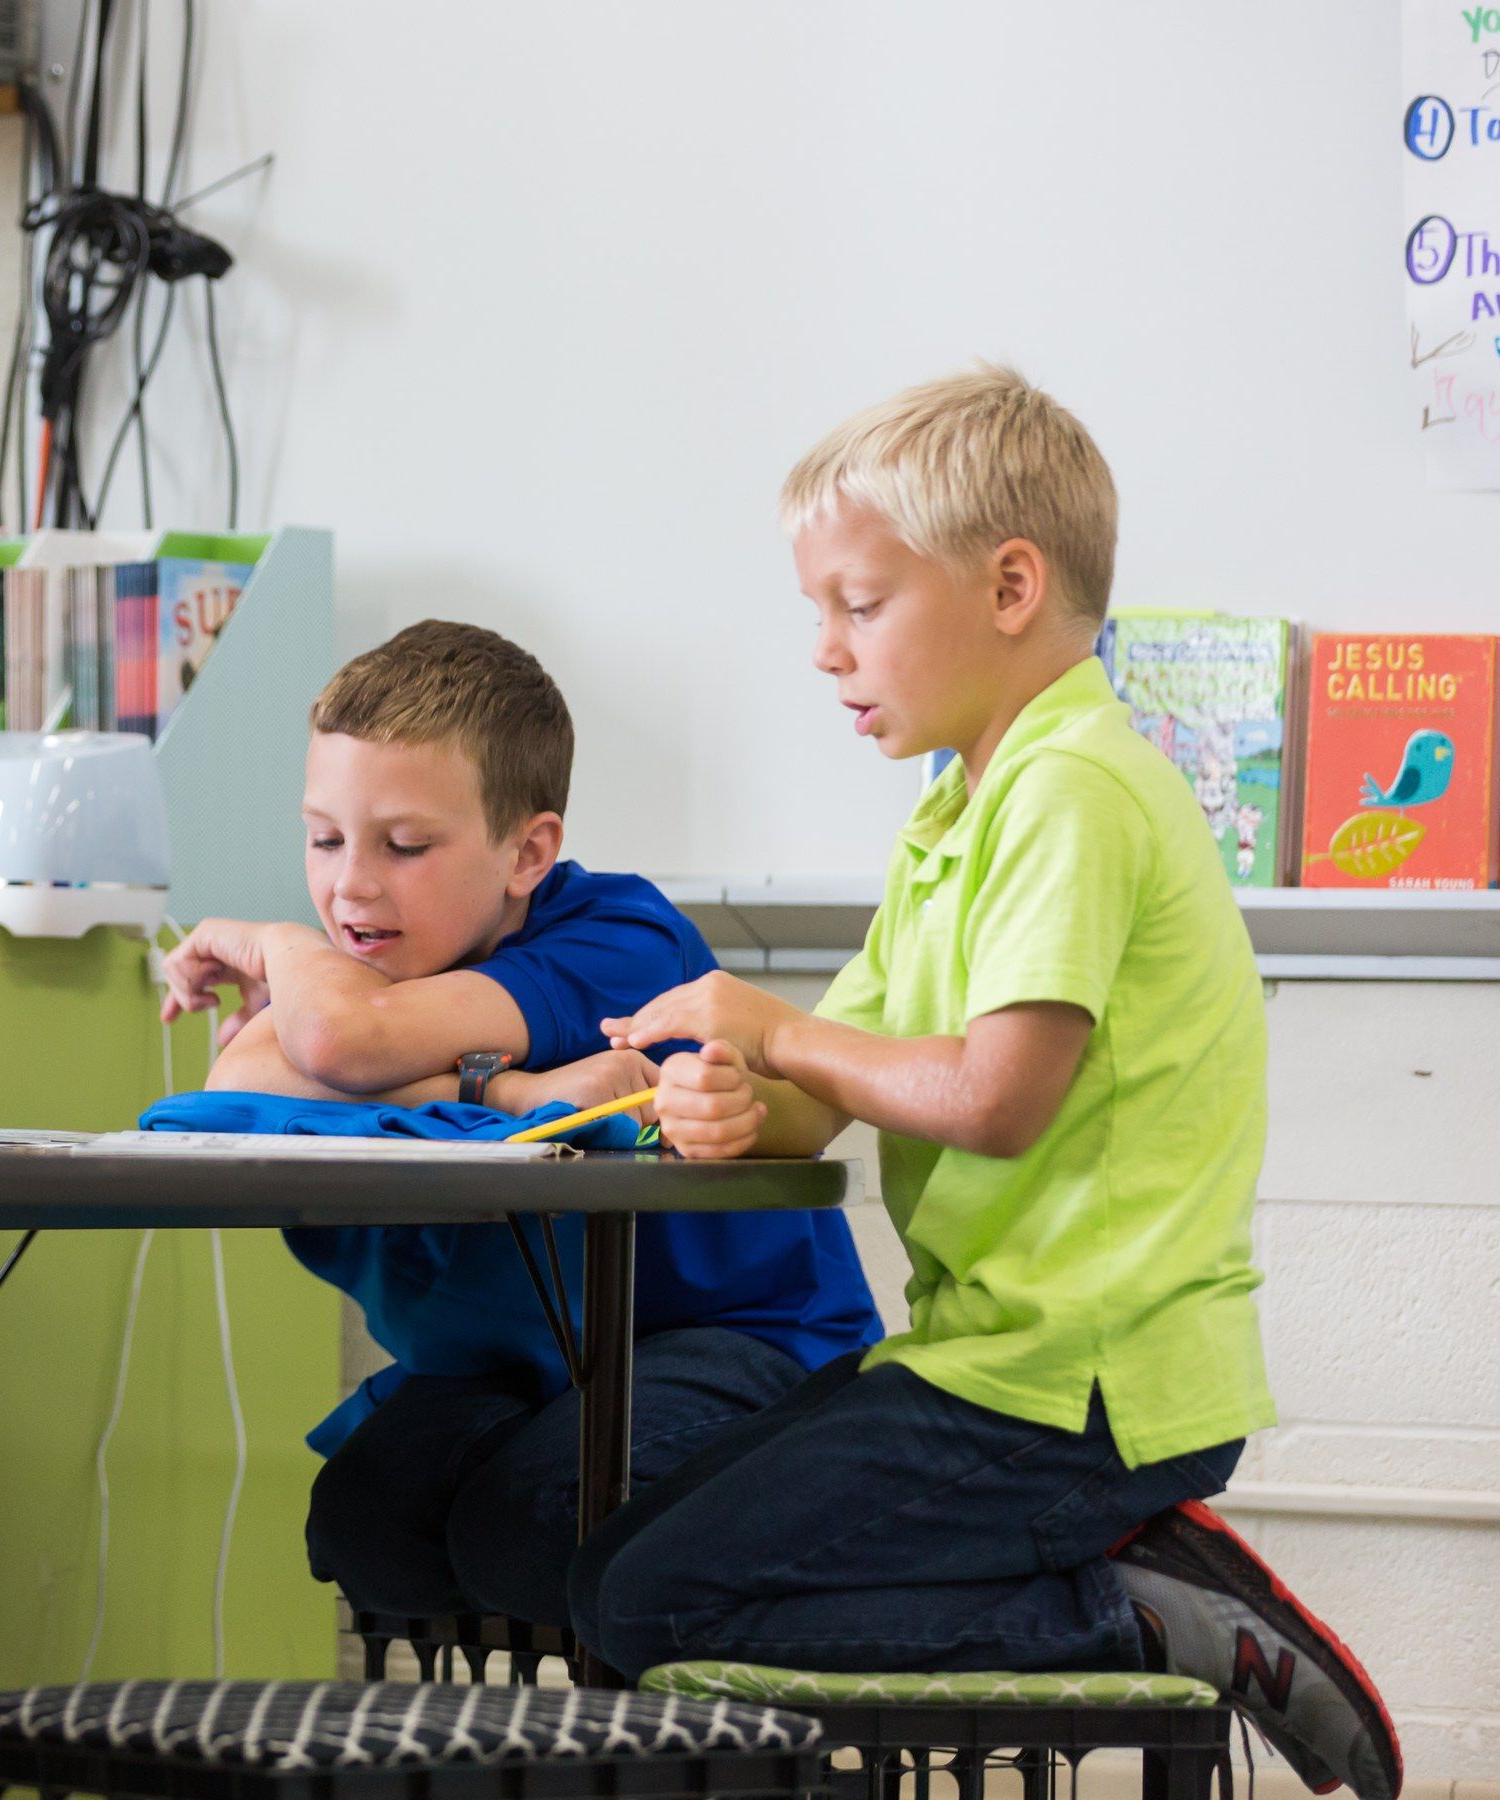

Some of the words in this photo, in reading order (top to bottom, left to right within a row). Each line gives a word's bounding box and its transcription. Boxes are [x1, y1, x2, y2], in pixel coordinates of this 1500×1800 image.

[1327, 642, 1425, 671] JESUS
[1327, 672, 1457, 701] CALLING
[1389, 876, 1431, 889] SARAH
[1435, 877, 1475, 890] YOUNG
[1230, 1625, 1296, 1715] N
